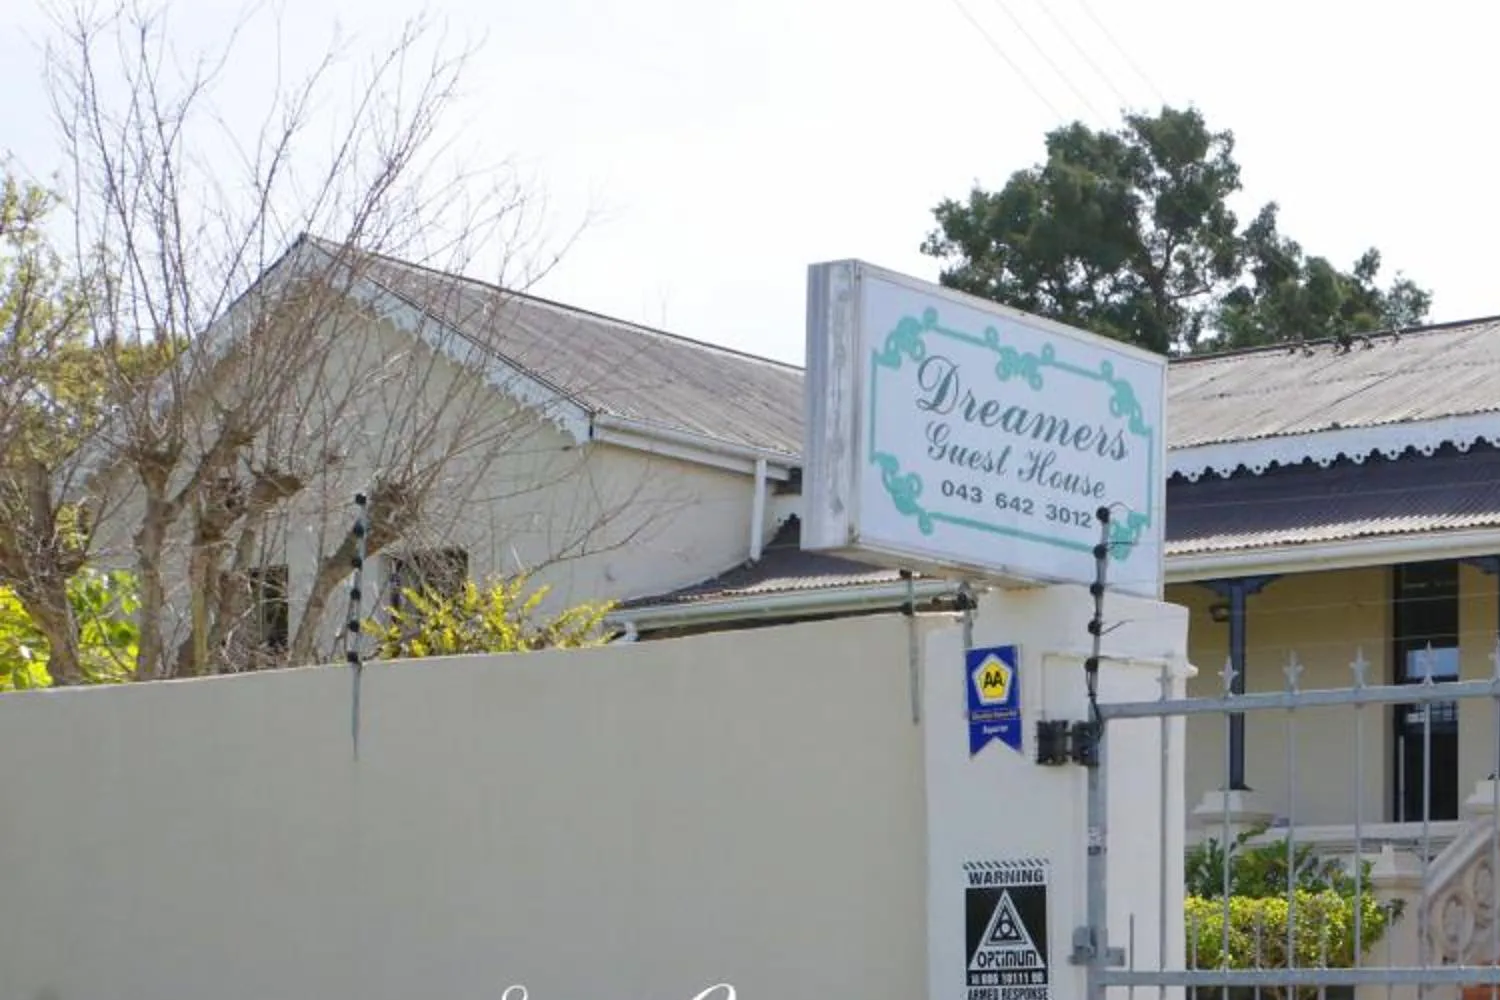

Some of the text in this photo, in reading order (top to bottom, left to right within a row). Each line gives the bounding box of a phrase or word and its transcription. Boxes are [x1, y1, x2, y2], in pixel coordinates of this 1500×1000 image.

[915, 354, 1127, 461] Dreamers
[924, 421, 1105, 499] Guest House
[942, 480, 1092, 529] 043 642 3012
[983, 671, 1005, 688] AA
[968, 869, 1044, 885] WARNING
